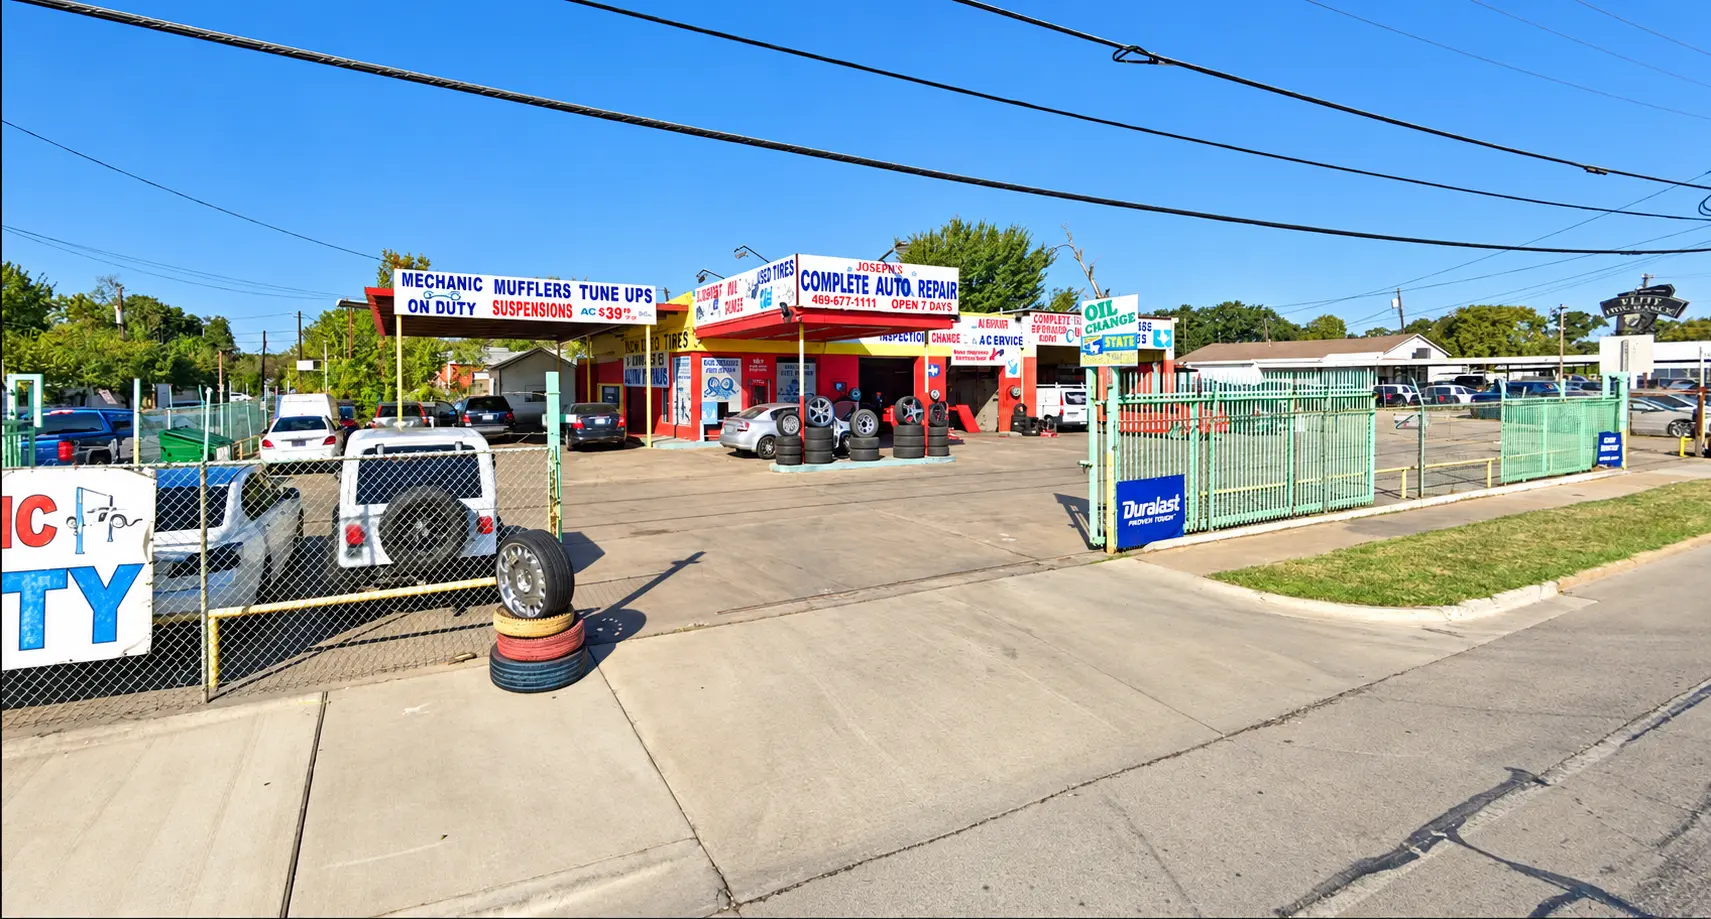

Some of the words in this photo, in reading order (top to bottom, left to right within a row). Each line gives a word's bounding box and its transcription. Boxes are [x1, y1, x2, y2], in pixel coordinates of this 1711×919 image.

[773, 259, 795, 281] TIRES
[402, 272, 483, 292] MECHANIC
[494, 279, 571, 299] MUFFLERS
[579, 284, 619, 302] TUNE
[625, 287, 653, 304] UPS
[801, 269, 869, 295] COMPLETE
[875, 276, 911, 297] AUTO
[918, 279, 957, 300] REPAIR
[408, 299, 429, 314] ON
[436, 301, 476, 316] DUTY
[492, 300, 573, 319] SUSPENSIONS
[580, 308, 596, 316] AC
[891, 298, 918, 310] OPEN
[921, 301, 927, 310] 7
[929, 301, 953, 312] DAYS
[1084, 300, 1118, 321] OIL
[1034, 314, 1071, 326] COMPLETE
[1085, 312, 1136, 334] CHANGE
[664, 331, 688, 350] TIRES
[1104, 335, 1135, 348] STATE
[1122, 494, 1180, 519] Duralast
[2, 563, 145, 651] TY
